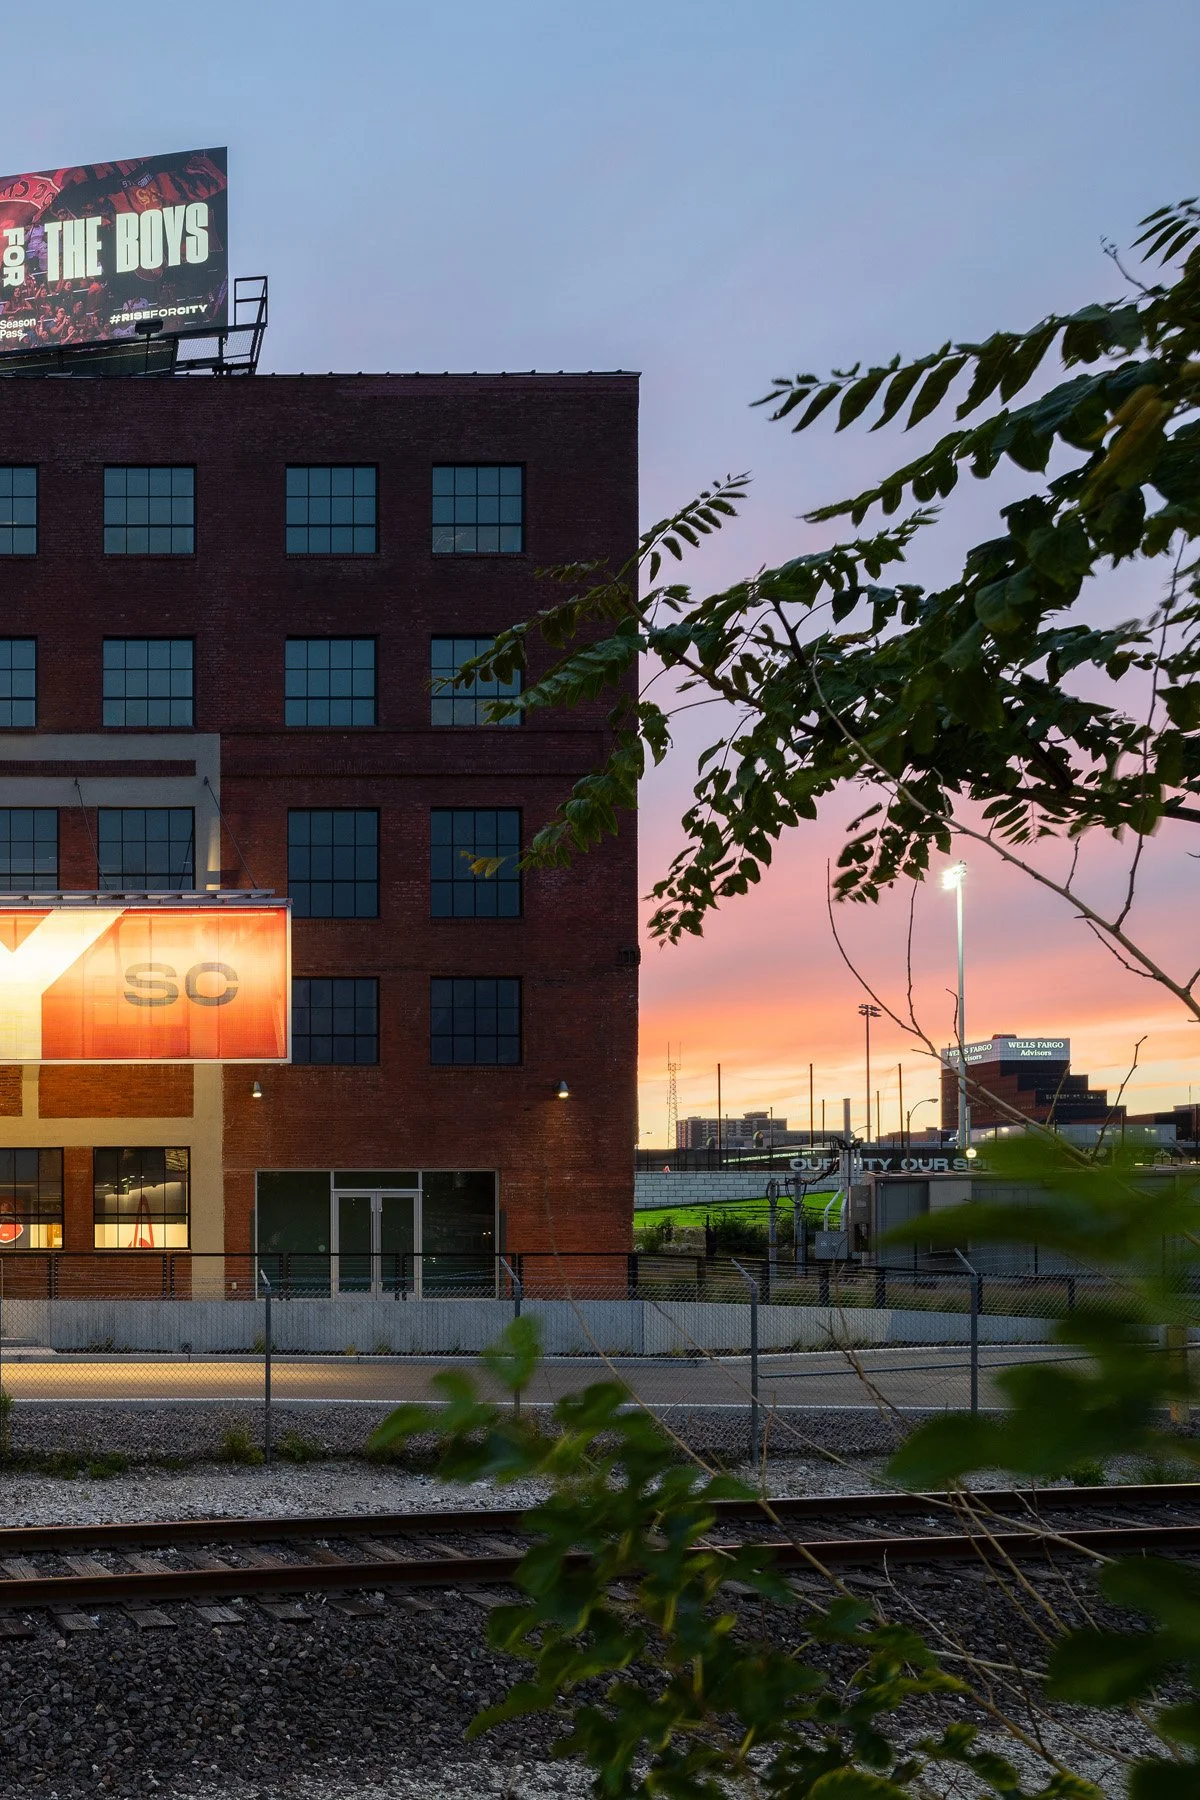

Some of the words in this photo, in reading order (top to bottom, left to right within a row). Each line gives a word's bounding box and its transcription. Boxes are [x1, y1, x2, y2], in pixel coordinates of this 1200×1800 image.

[3, 227, 25, 287] FOR
[44, 216, 102, 282] THE
[117, 202, 209, 273] BOYS
[109, 304, 208, 324] #RISEFORCITY
[0, 318, 36, 329] Season
[123, 962, 238, 1008] SC
[1008, 1041, 1035, 1049] WELLS
[1037, 1041, 1064, 1049] FARGO
[1020, 1049, 1052, 1057] Advisors
[900, 1157, 949, 1171] OUR
